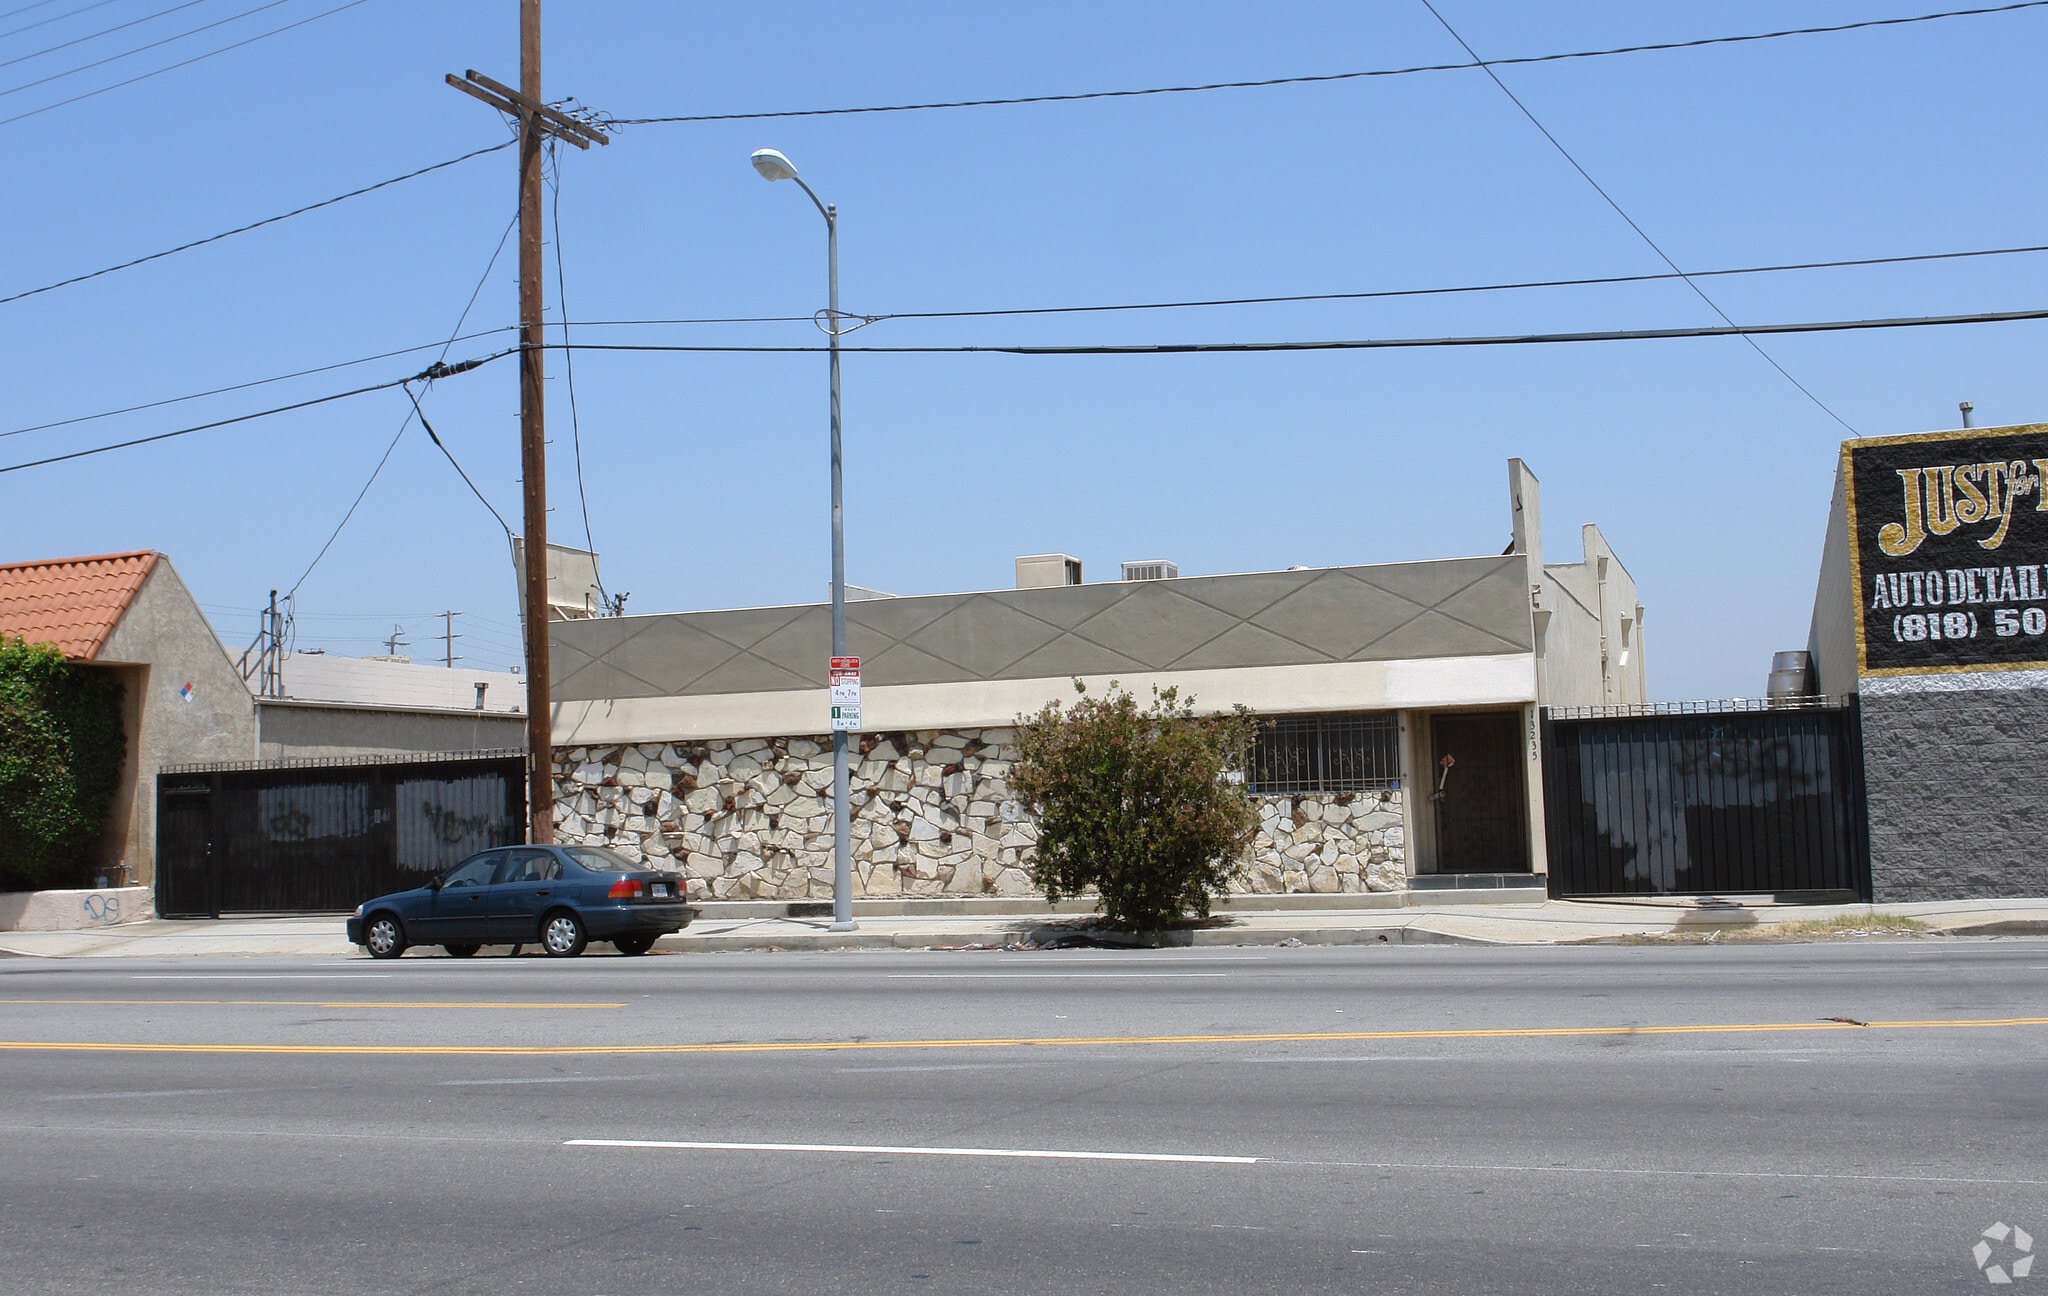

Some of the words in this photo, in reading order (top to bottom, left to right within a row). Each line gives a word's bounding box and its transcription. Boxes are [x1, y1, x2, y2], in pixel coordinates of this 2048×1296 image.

[1878, 461, 2008, 557] JUST
[1977, 460, 2039, 550] for
[1871, 571, 1944, 609] AUTO
[1945, 564, 2048, 605] DETAIL
[1892, 612, 1978, 642] (818)
[1994, 607, 2047, 637] 50
[831, 676, 840, 686] NO
[1530, 709, 1538, 760] 13235
